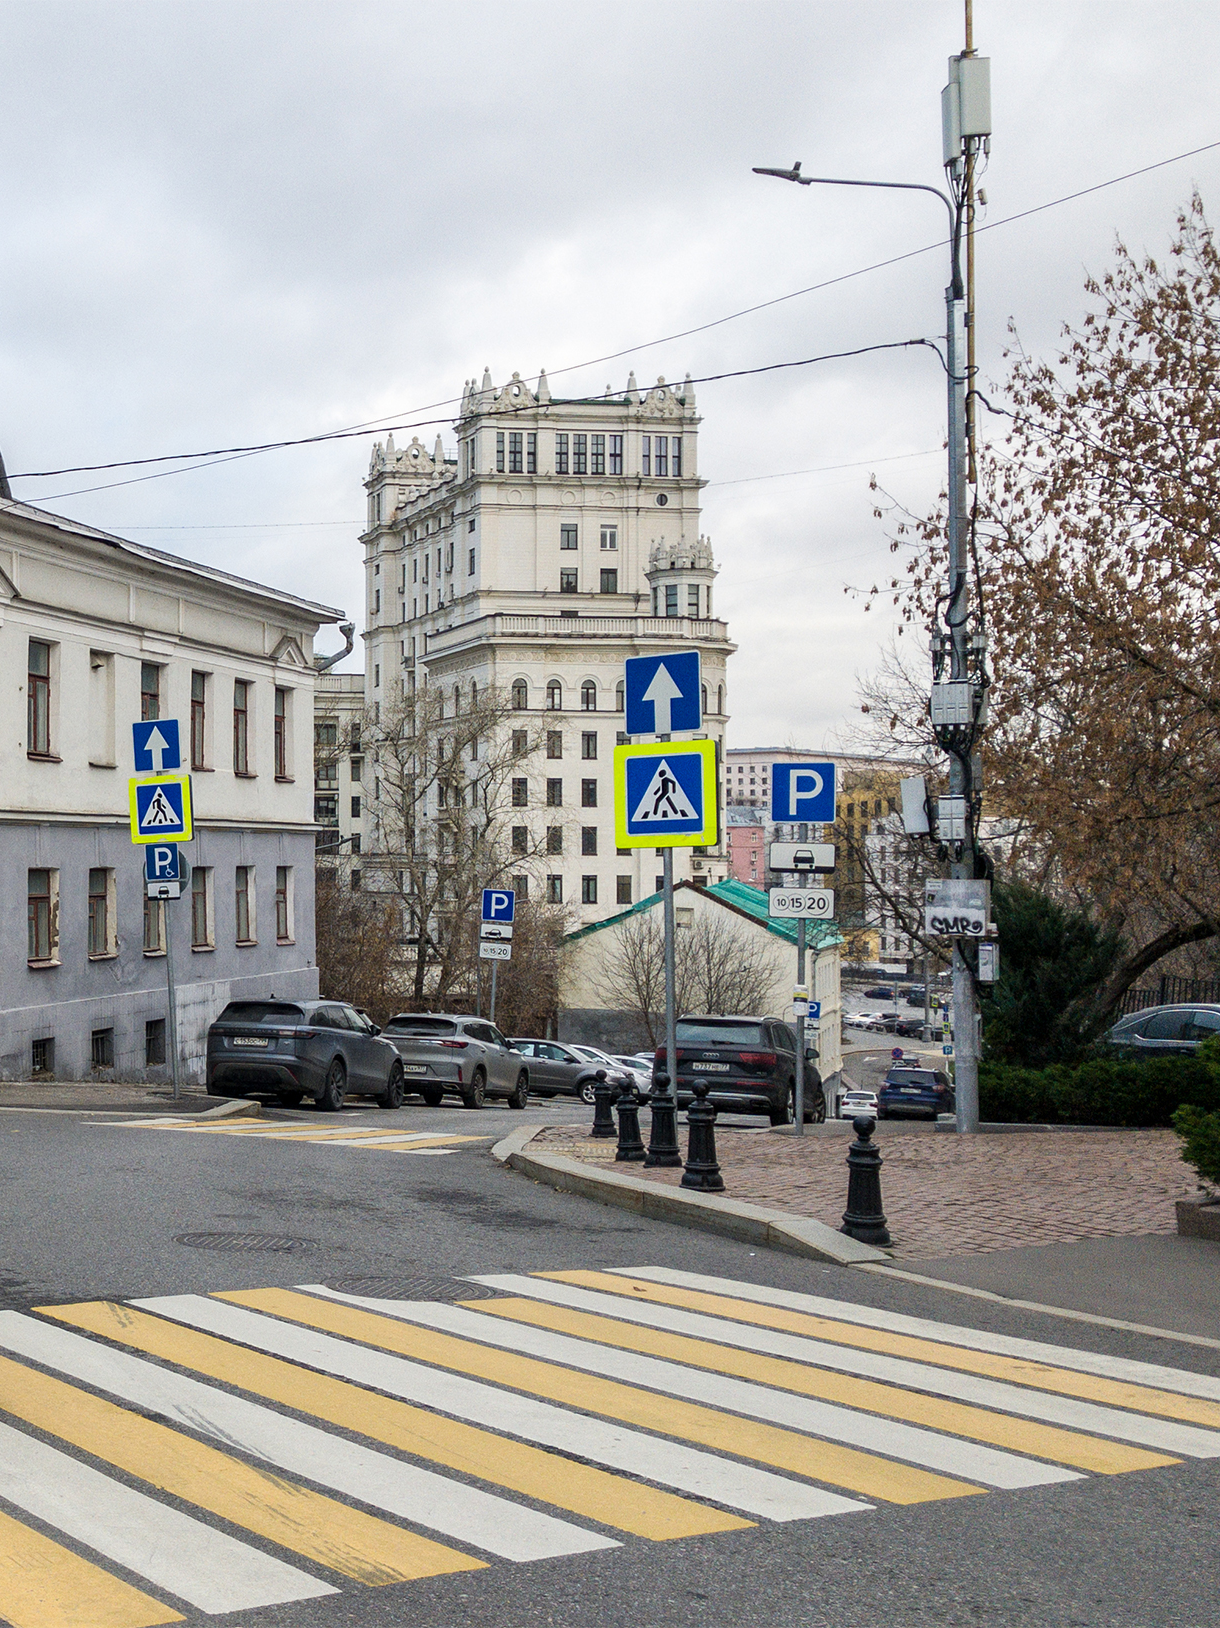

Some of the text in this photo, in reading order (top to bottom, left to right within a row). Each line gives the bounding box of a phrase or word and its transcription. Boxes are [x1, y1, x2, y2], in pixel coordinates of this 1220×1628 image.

[789, 769, 823, 816] P
[154, 847, 172, 876] P
[491, 893, 509, 917] P
[776, 897, 826, 910] 10 15 20
